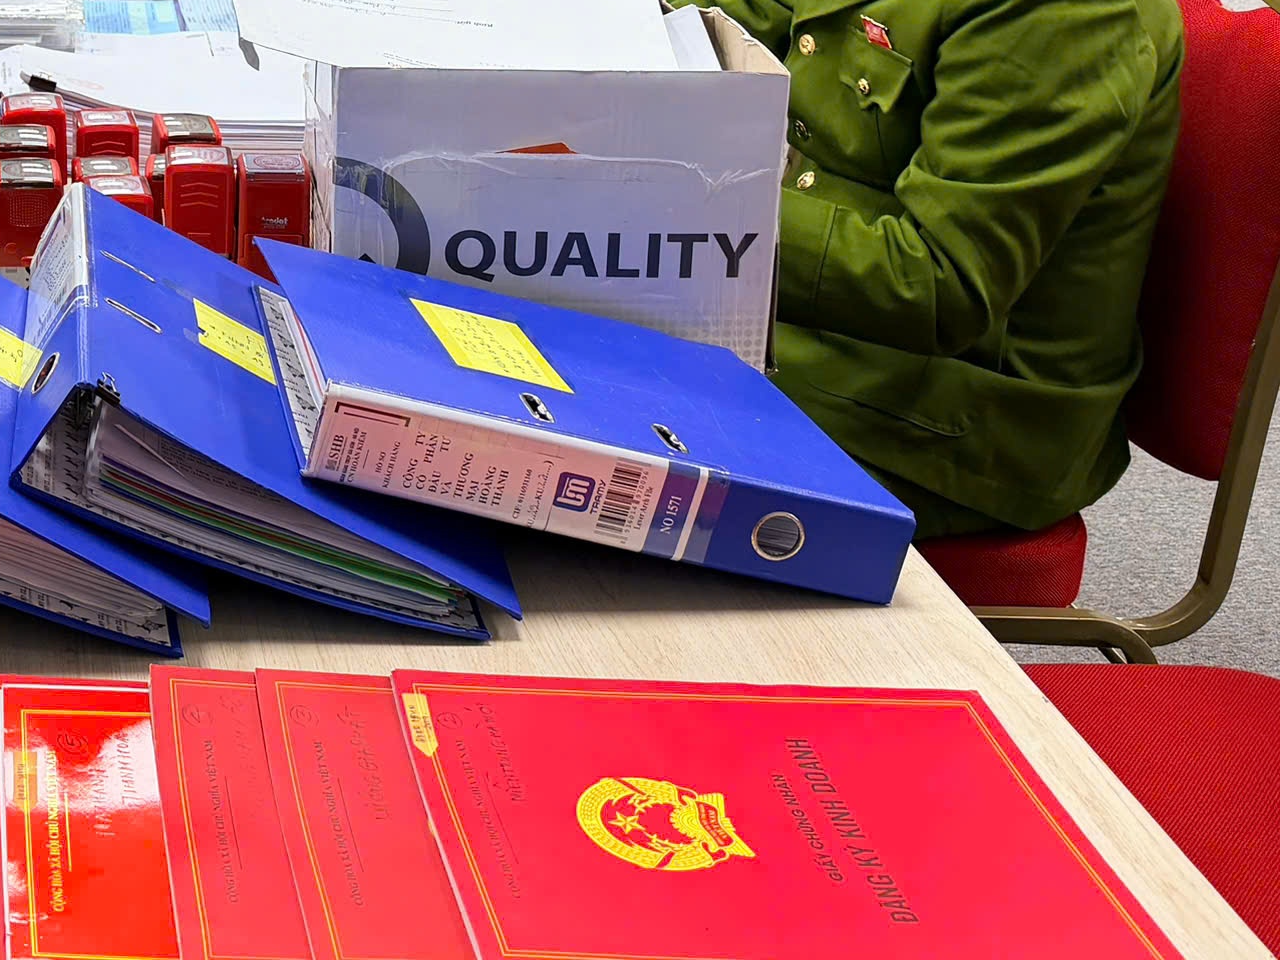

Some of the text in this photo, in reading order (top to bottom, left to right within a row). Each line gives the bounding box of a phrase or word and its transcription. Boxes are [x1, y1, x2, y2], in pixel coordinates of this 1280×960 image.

[445, 230, 759, 282] QUALITY
[330, 434, 344, 460] SHB
[403, 431, 426, 488] CÔNG TY
[440, 436, 452, 452] TƯ
[440, 481, 452, 495] VÀ
[453, 452, 474, 498] THƯƠNG
[466, 480, 479, 501] MẠI
[478, 466, 497, 504] HOÀNG
[491, 470, 509, 506] THÀNH
[660, 496, 682, 534] NO 1571
[771, 774, 843, 882] GIẤY CHỨNG NHẬN
[784, 738, 918, 922] ĐĂNG KÝ KINH DOANH
